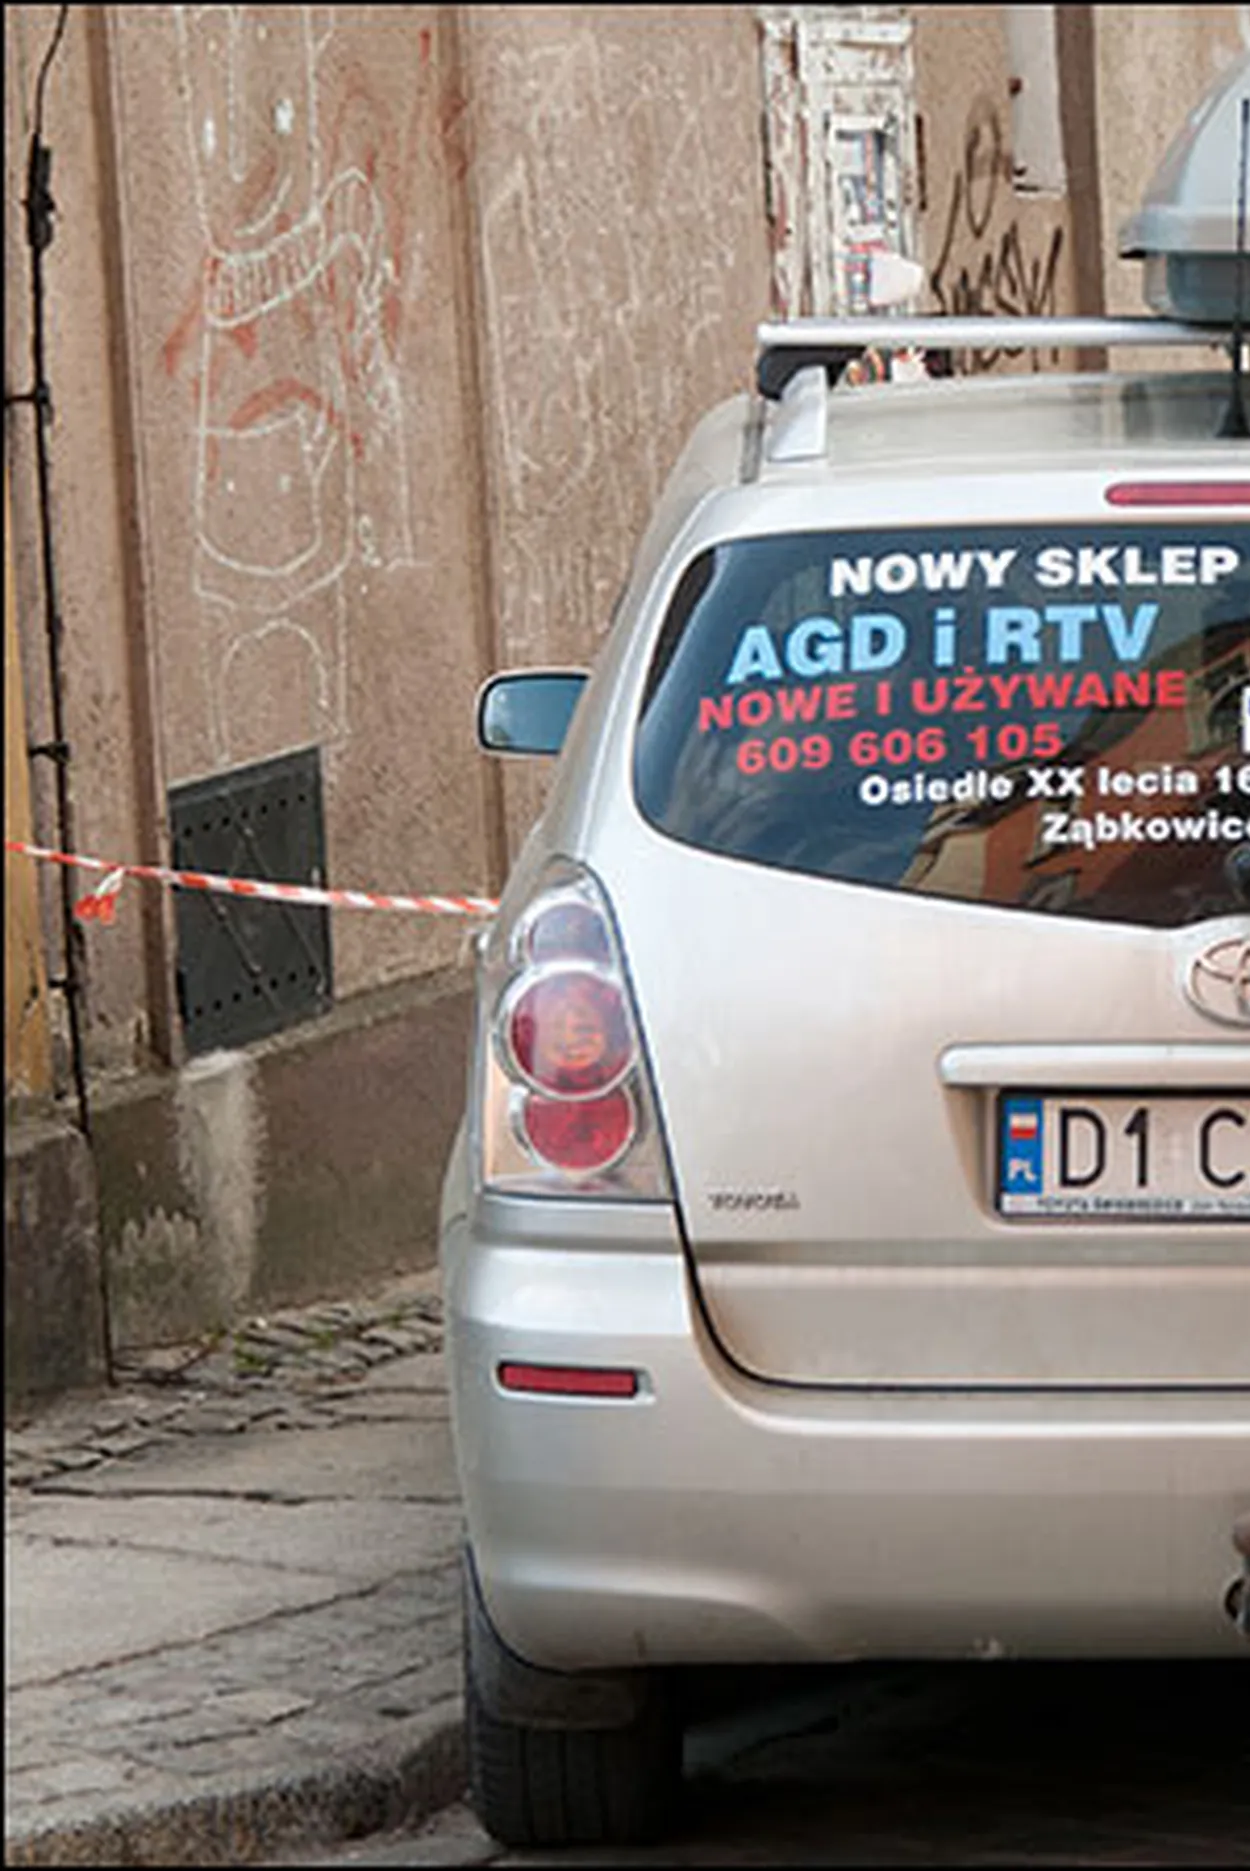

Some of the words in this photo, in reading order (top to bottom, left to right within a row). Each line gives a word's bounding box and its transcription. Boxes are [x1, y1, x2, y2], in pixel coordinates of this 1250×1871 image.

[831, 548, 1017, 596] NOWY
[1037, 547, 1239, 586] SKLEP
[726, 614, 904, 684] AGD
[935, 609, 954, 667] i
[987, 604, 1160, 664] RTV
[700, 684, 857, 731] NOWE
[878, 681, 891, 715] I
[911, 666, 1187, 714] UŻYWANE
[737, 736, 831, 775] 609
[850, 728, 946, 767] 606
[967, 723, 1063, 759] 105
[860, 769, 1012, 805] Osiedle
[1026, 767, 1085, 798] XX
[1099, 767, 1199, 796] lecia
[1059, 1107, 1149, 1188] D1
